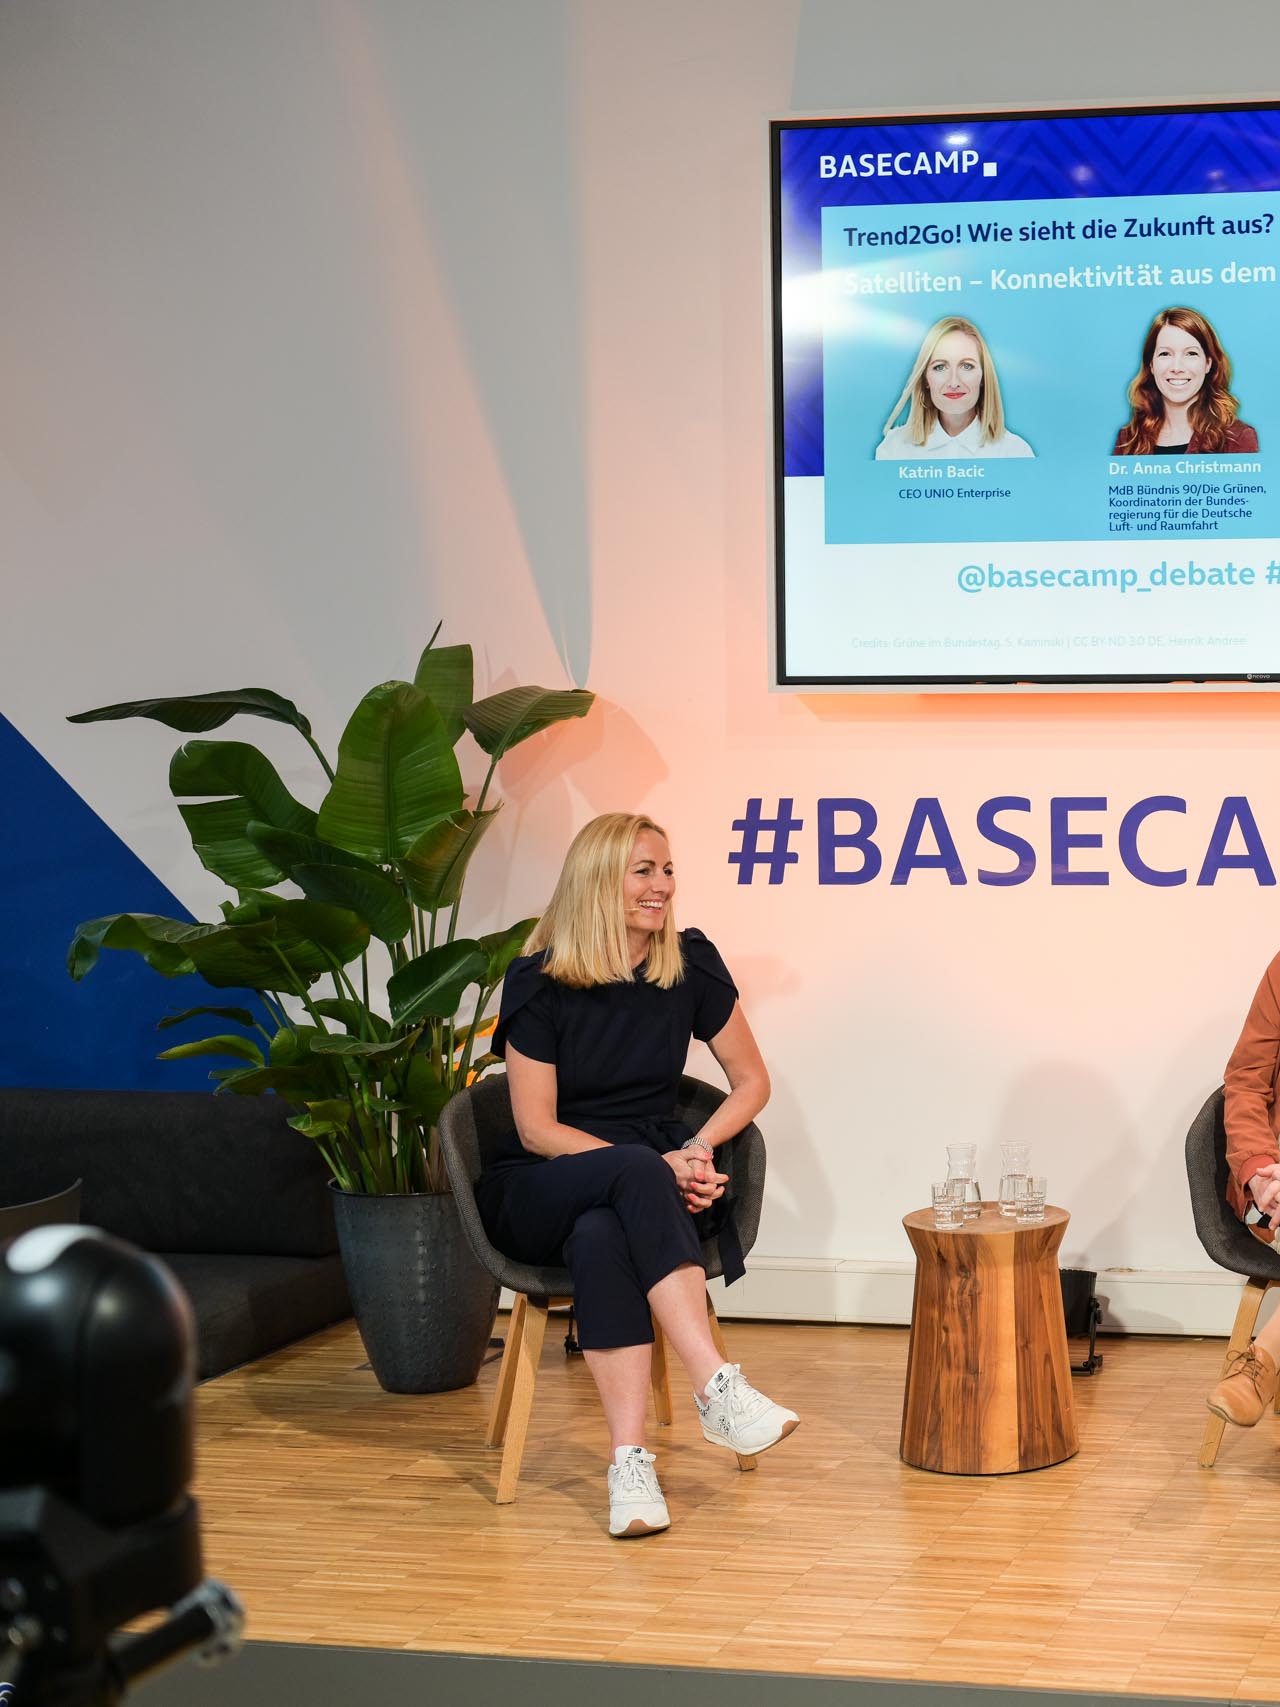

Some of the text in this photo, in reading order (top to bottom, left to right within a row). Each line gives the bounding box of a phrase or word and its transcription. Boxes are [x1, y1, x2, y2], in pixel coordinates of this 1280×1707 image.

[844, 214, 1274, 247] Trend2Go! Wie sieht die Zukunft aus?
[844, 271, 962, 294] Satelliten
[991, 265, 1162, 291] Konnektivität
[1171, 265, 1213, 284] aus
[1221, 261, 1276, 283] dem
[899, 465, 985, 478] Katrin Bacic
[1109, 461, 1261, 475] Dr. Anna Christmann
[899, 488, 1011, 500] CEO UNIO Enterprise
[1109, 484, 1267, 496] MdB Bündnis 90/Die Grünen,
[1109, 496, 1248, 507] Koordinatorin der Bundes-
[1109, 508, 1252, 521] regierung für die Deutsche
[1109, 521, 1218, 531] Luft- und Raumfahrt
[957, 561, 1256, 593] @basecamp_debate
